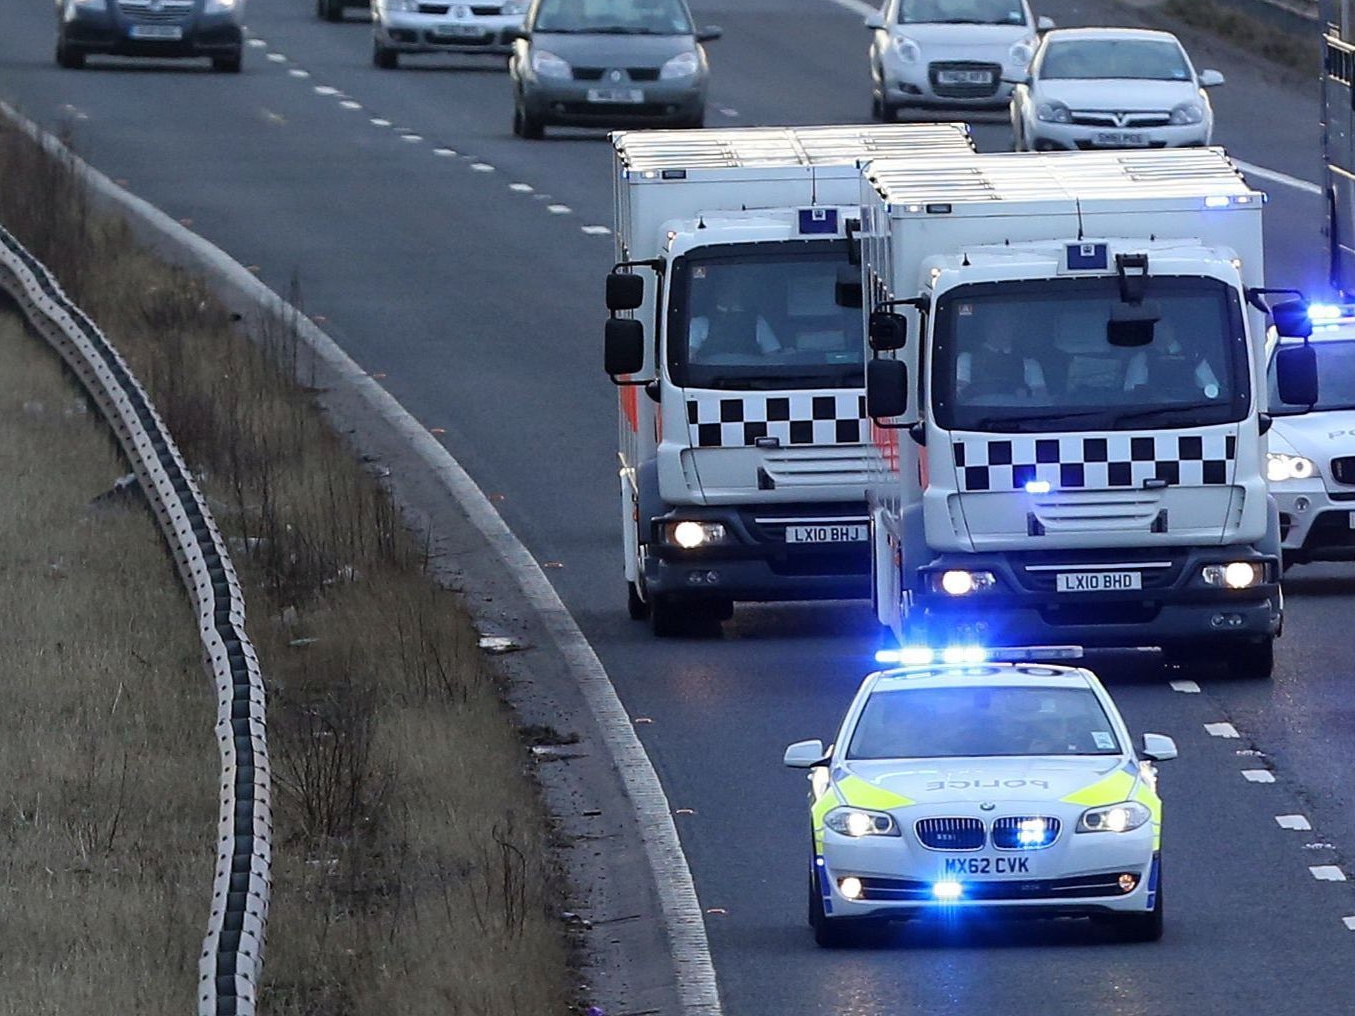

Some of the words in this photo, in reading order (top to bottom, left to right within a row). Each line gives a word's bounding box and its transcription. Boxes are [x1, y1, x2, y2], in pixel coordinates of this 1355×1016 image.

[794, 528, 827, 542] LX10
[830, 527, 859, 541] BHJ
[1065, 575, 1099, 590] LX10
[1103, 574, 1132, 589] BHD
[945, 857, 991, 874] MX62
[995, 857, 1030, 873] CVK
